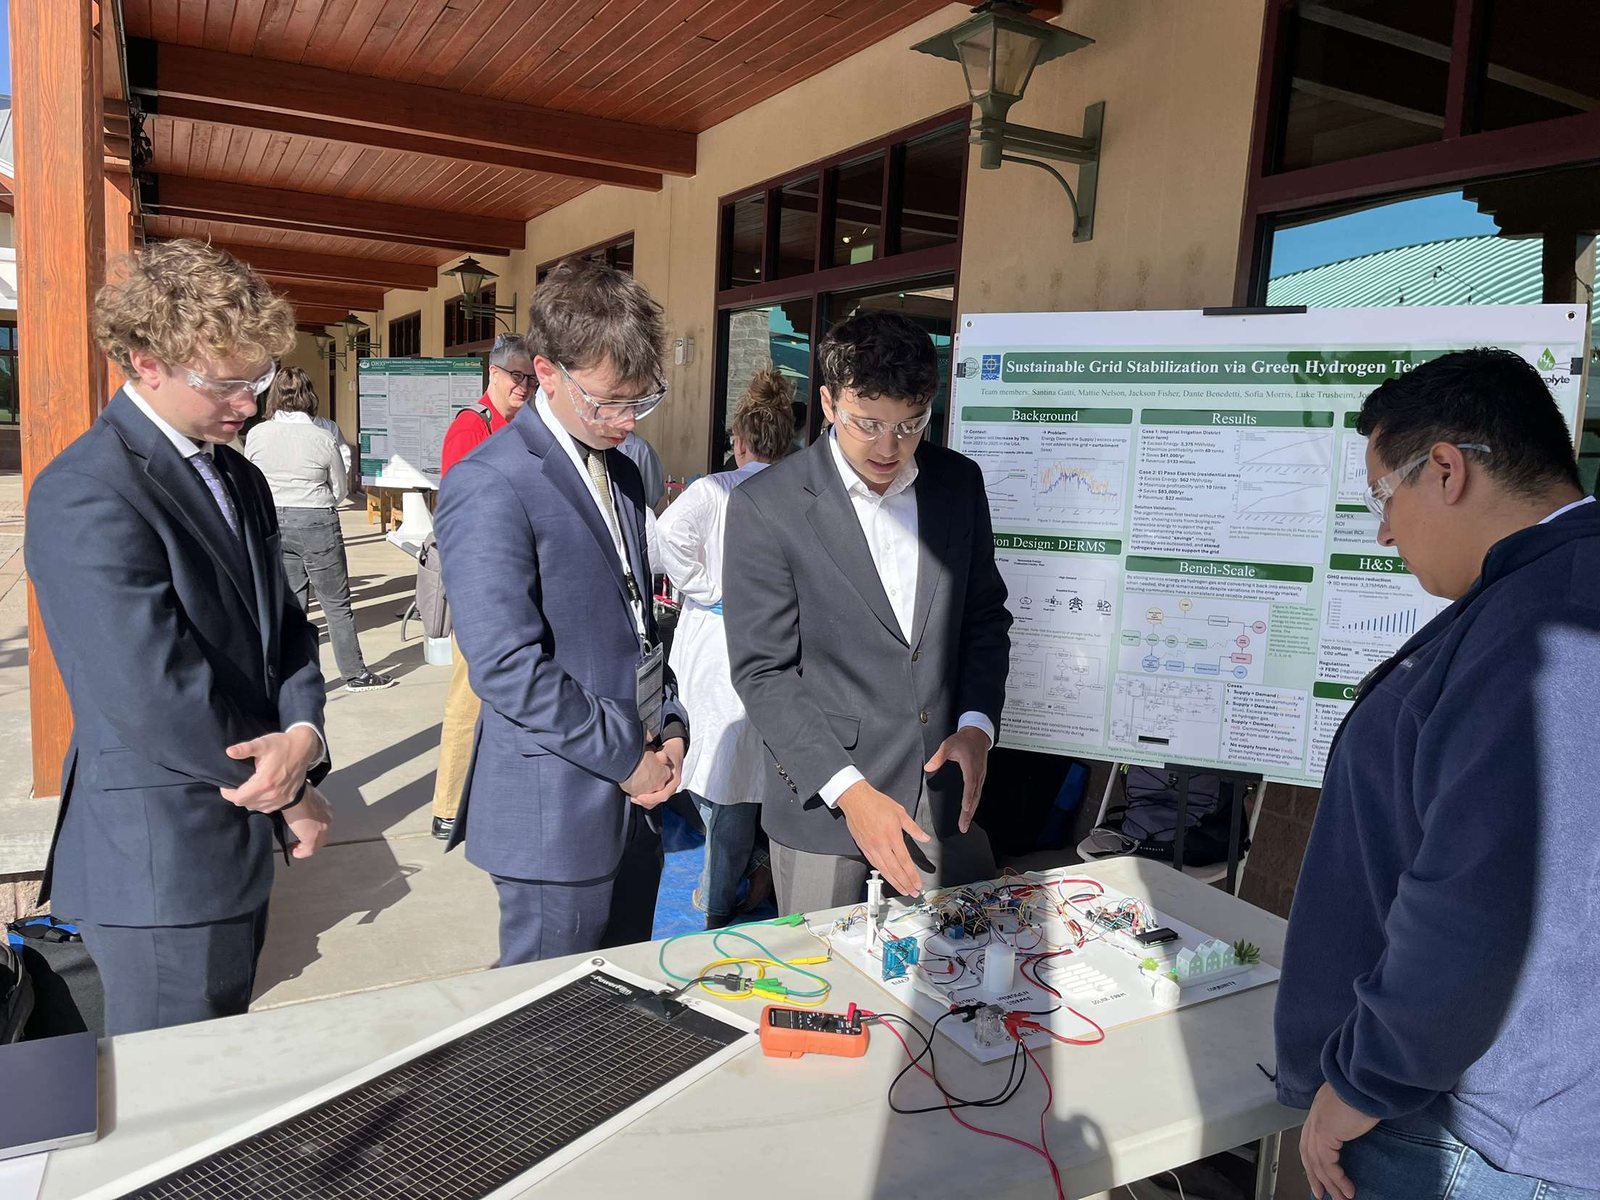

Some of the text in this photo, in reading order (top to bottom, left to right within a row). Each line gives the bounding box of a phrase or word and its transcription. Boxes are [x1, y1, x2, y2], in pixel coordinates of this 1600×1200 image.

[1006, 360, 1085, 373] Sustainable
[1089, 360, 1122, 373] Grid
[1126, 360, 1219, 373] Stabilization
[1224, 360, 1246, 373] via
[1252, 360, 1299, 374] Green
[1305, 360, 1386, 377] Hydrogen
[1012, 410, 1078, 422] Background
[1212, 413, 1257, 424] Results
[994, 537, 1106, 552] ion Design: DERMS
[1180, 562, 1256, 577] Bench-Scale
[1360, 558, 1393, 571] H&S
[1343, 687, 1358, 700] C
